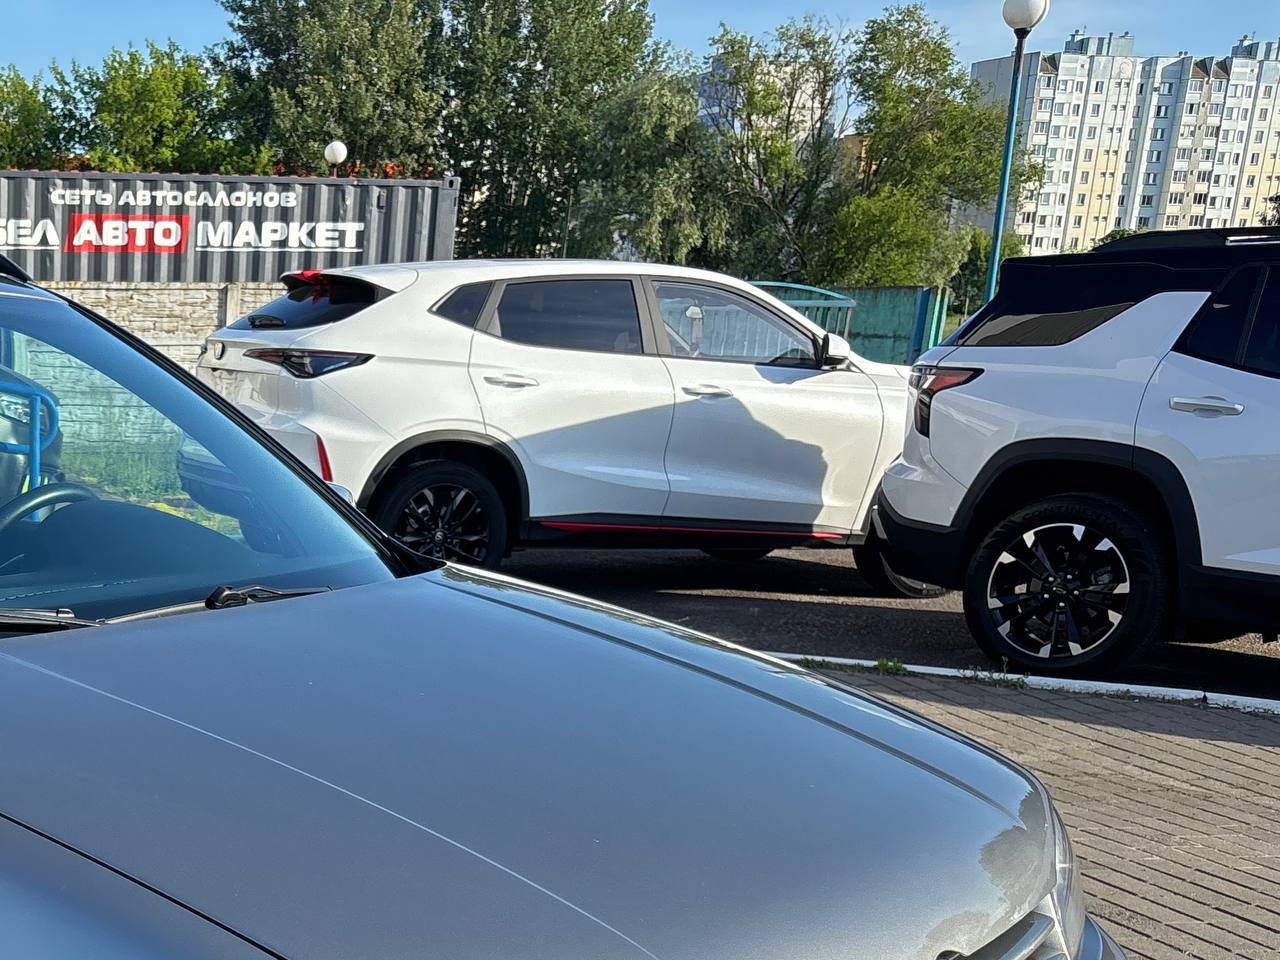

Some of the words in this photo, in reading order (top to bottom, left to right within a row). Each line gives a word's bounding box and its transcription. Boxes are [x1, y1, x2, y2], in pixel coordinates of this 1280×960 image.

[50, 189, 113, 206] СЕТЬ
[118, 190, 297, 208] АВТОСАЛОНОВ
[72, 219, 182, 247] АВТО
[196, 220, 365, 249] МАРКЕТ
